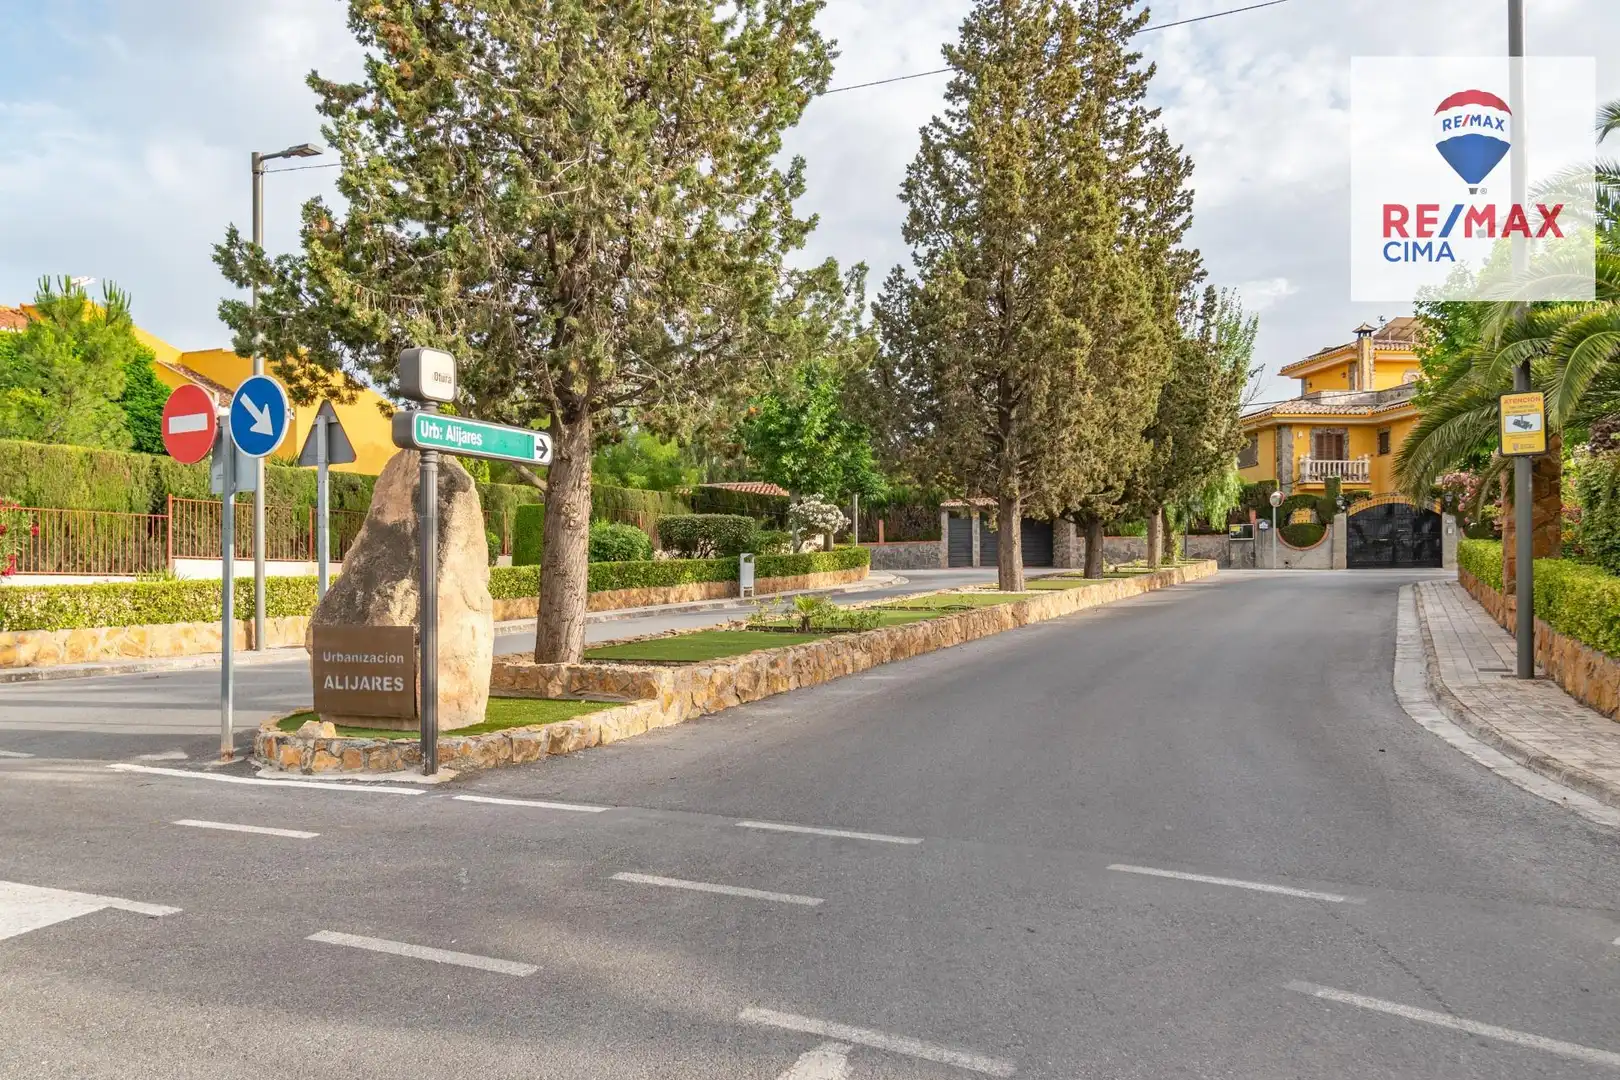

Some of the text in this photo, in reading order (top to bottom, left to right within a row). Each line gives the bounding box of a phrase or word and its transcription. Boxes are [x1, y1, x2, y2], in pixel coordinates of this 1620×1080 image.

[420, 420, 483, 446] Urb: Alijares
[324, 674, 404, 692] ALIJARES
